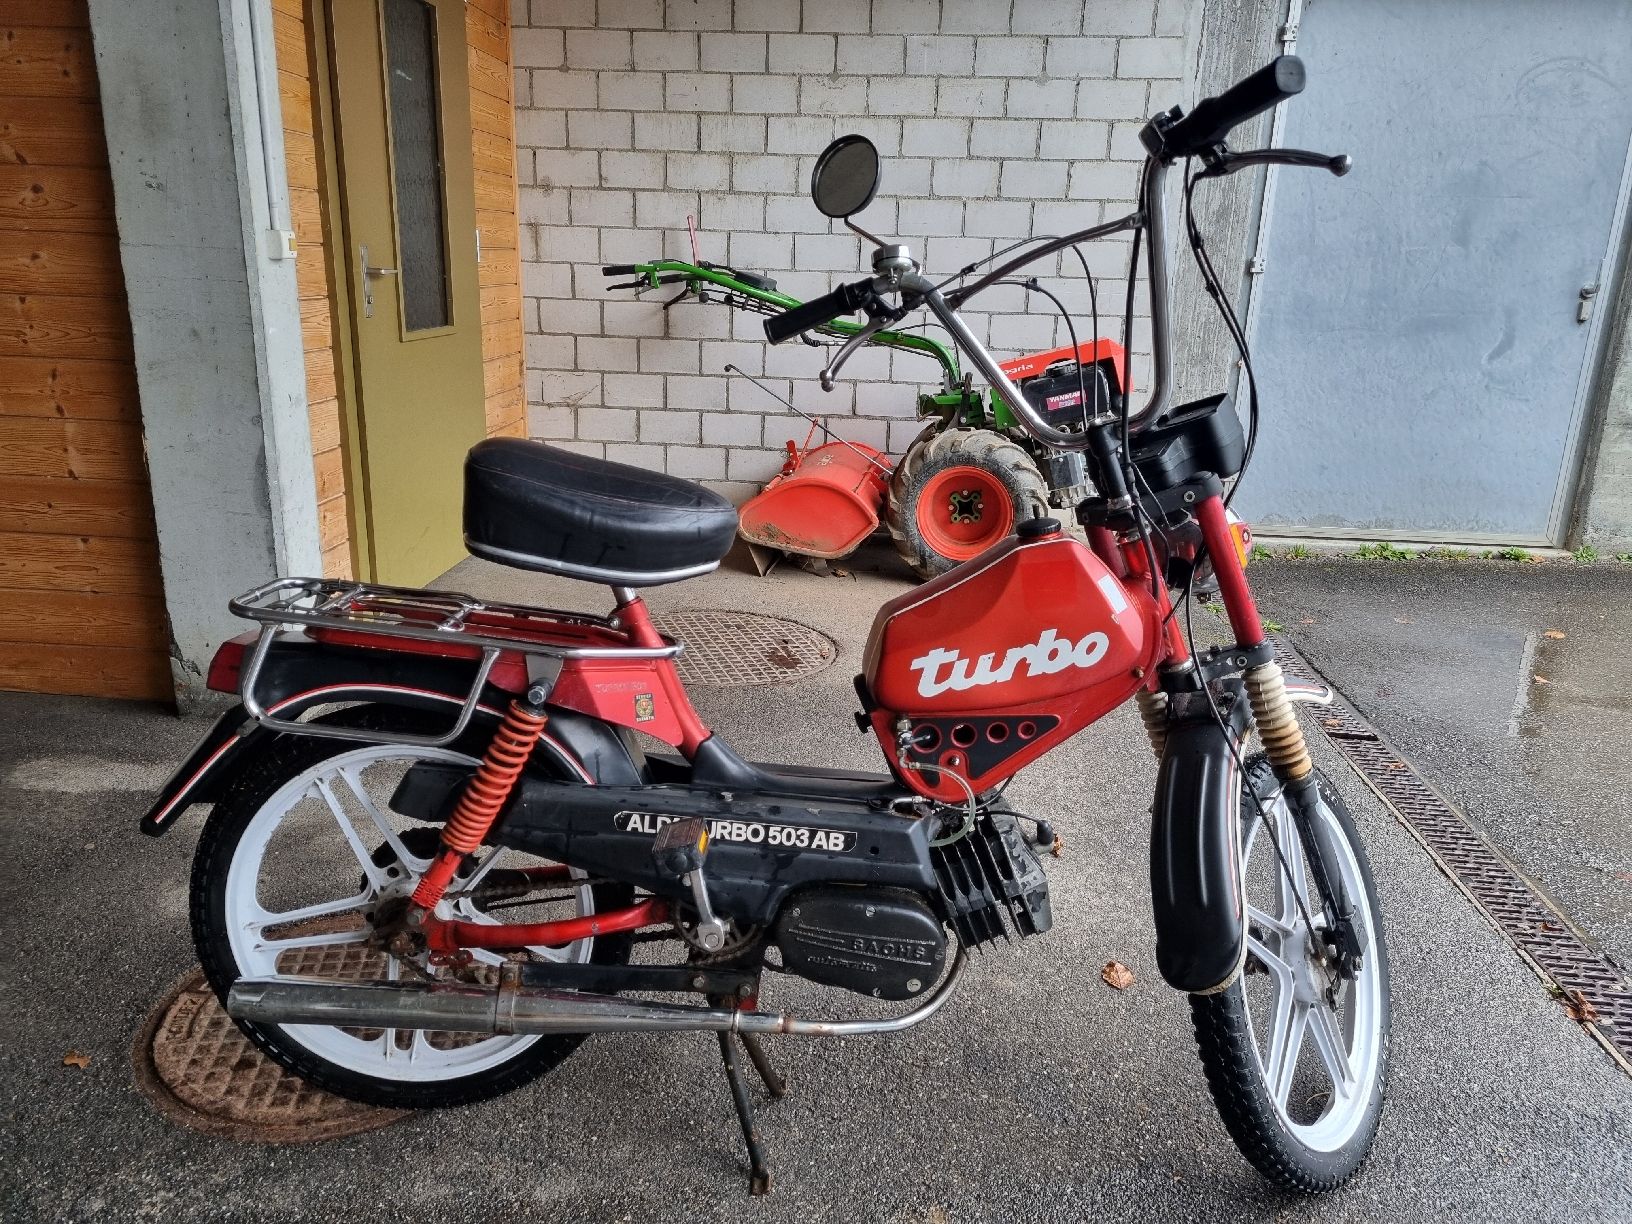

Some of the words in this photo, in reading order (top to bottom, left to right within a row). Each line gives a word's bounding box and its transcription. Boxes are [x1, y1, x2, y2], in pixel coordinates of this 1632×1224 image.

[910, 628, 1110, 698] turbo
[707, 821, 765, 843] URBO
[768, 826, 809, 848] 503
[811, 831, 845, 851] AB
[853, 938, 926, 958] SACHS
